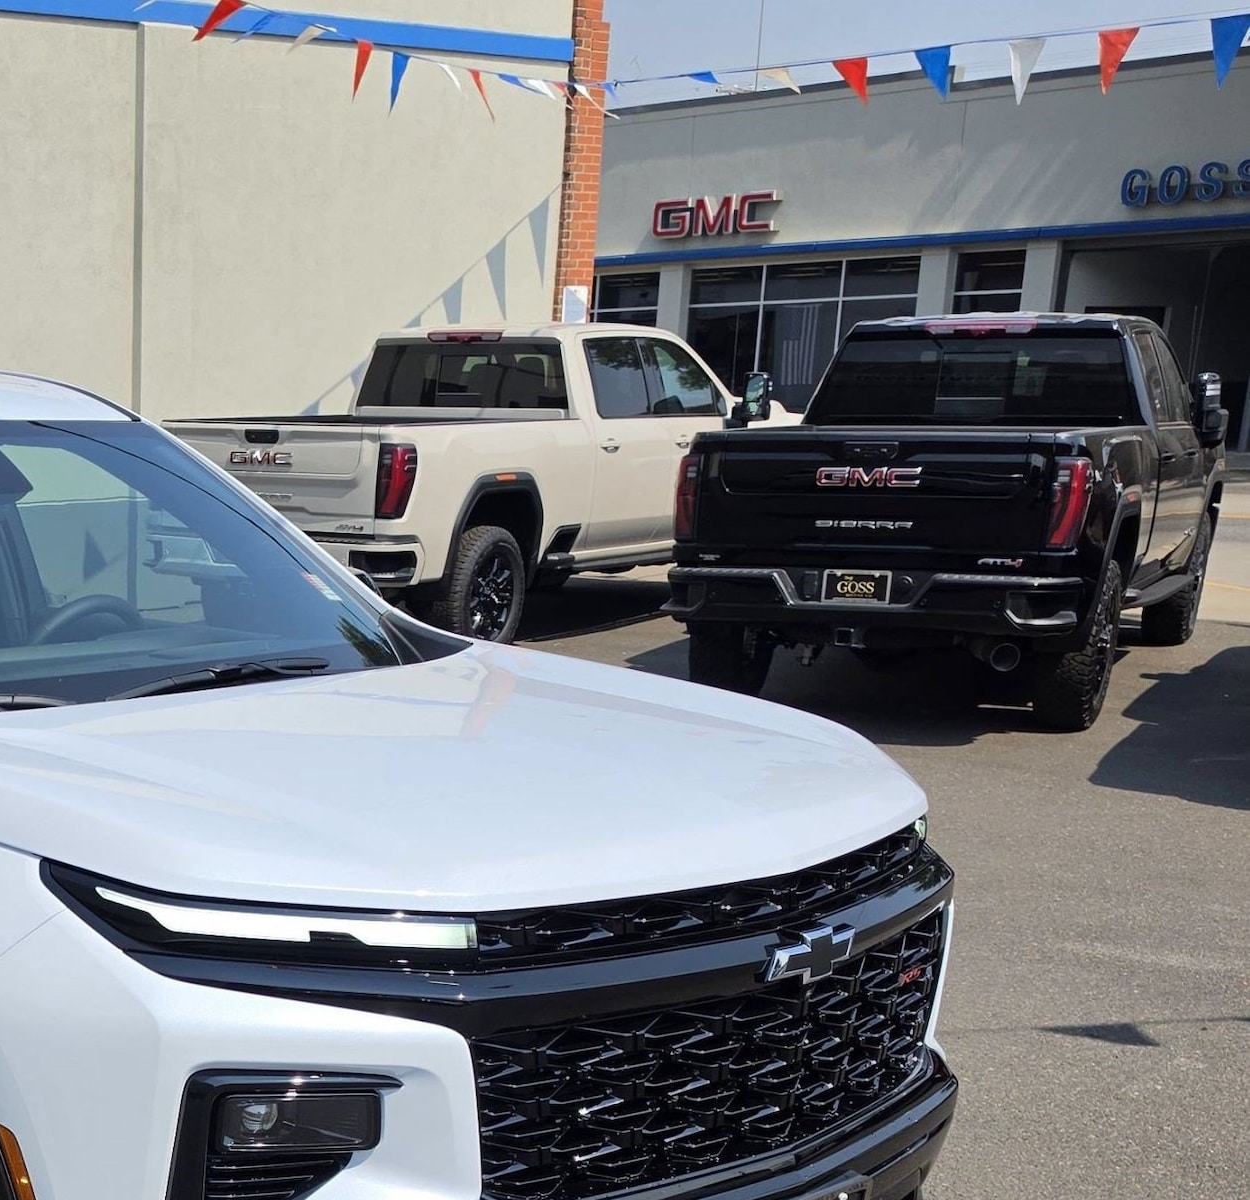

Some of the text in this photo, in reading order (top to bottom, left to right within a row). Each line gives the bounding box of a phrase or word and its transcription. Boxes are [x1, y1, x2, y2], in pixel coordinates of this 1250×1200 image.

[653, 190, 777, 238] GMC
[230, 450, 293, 468] GMC
[816, 466, 922, 487] GMC
[836, 581, 875, 594] GOSS
